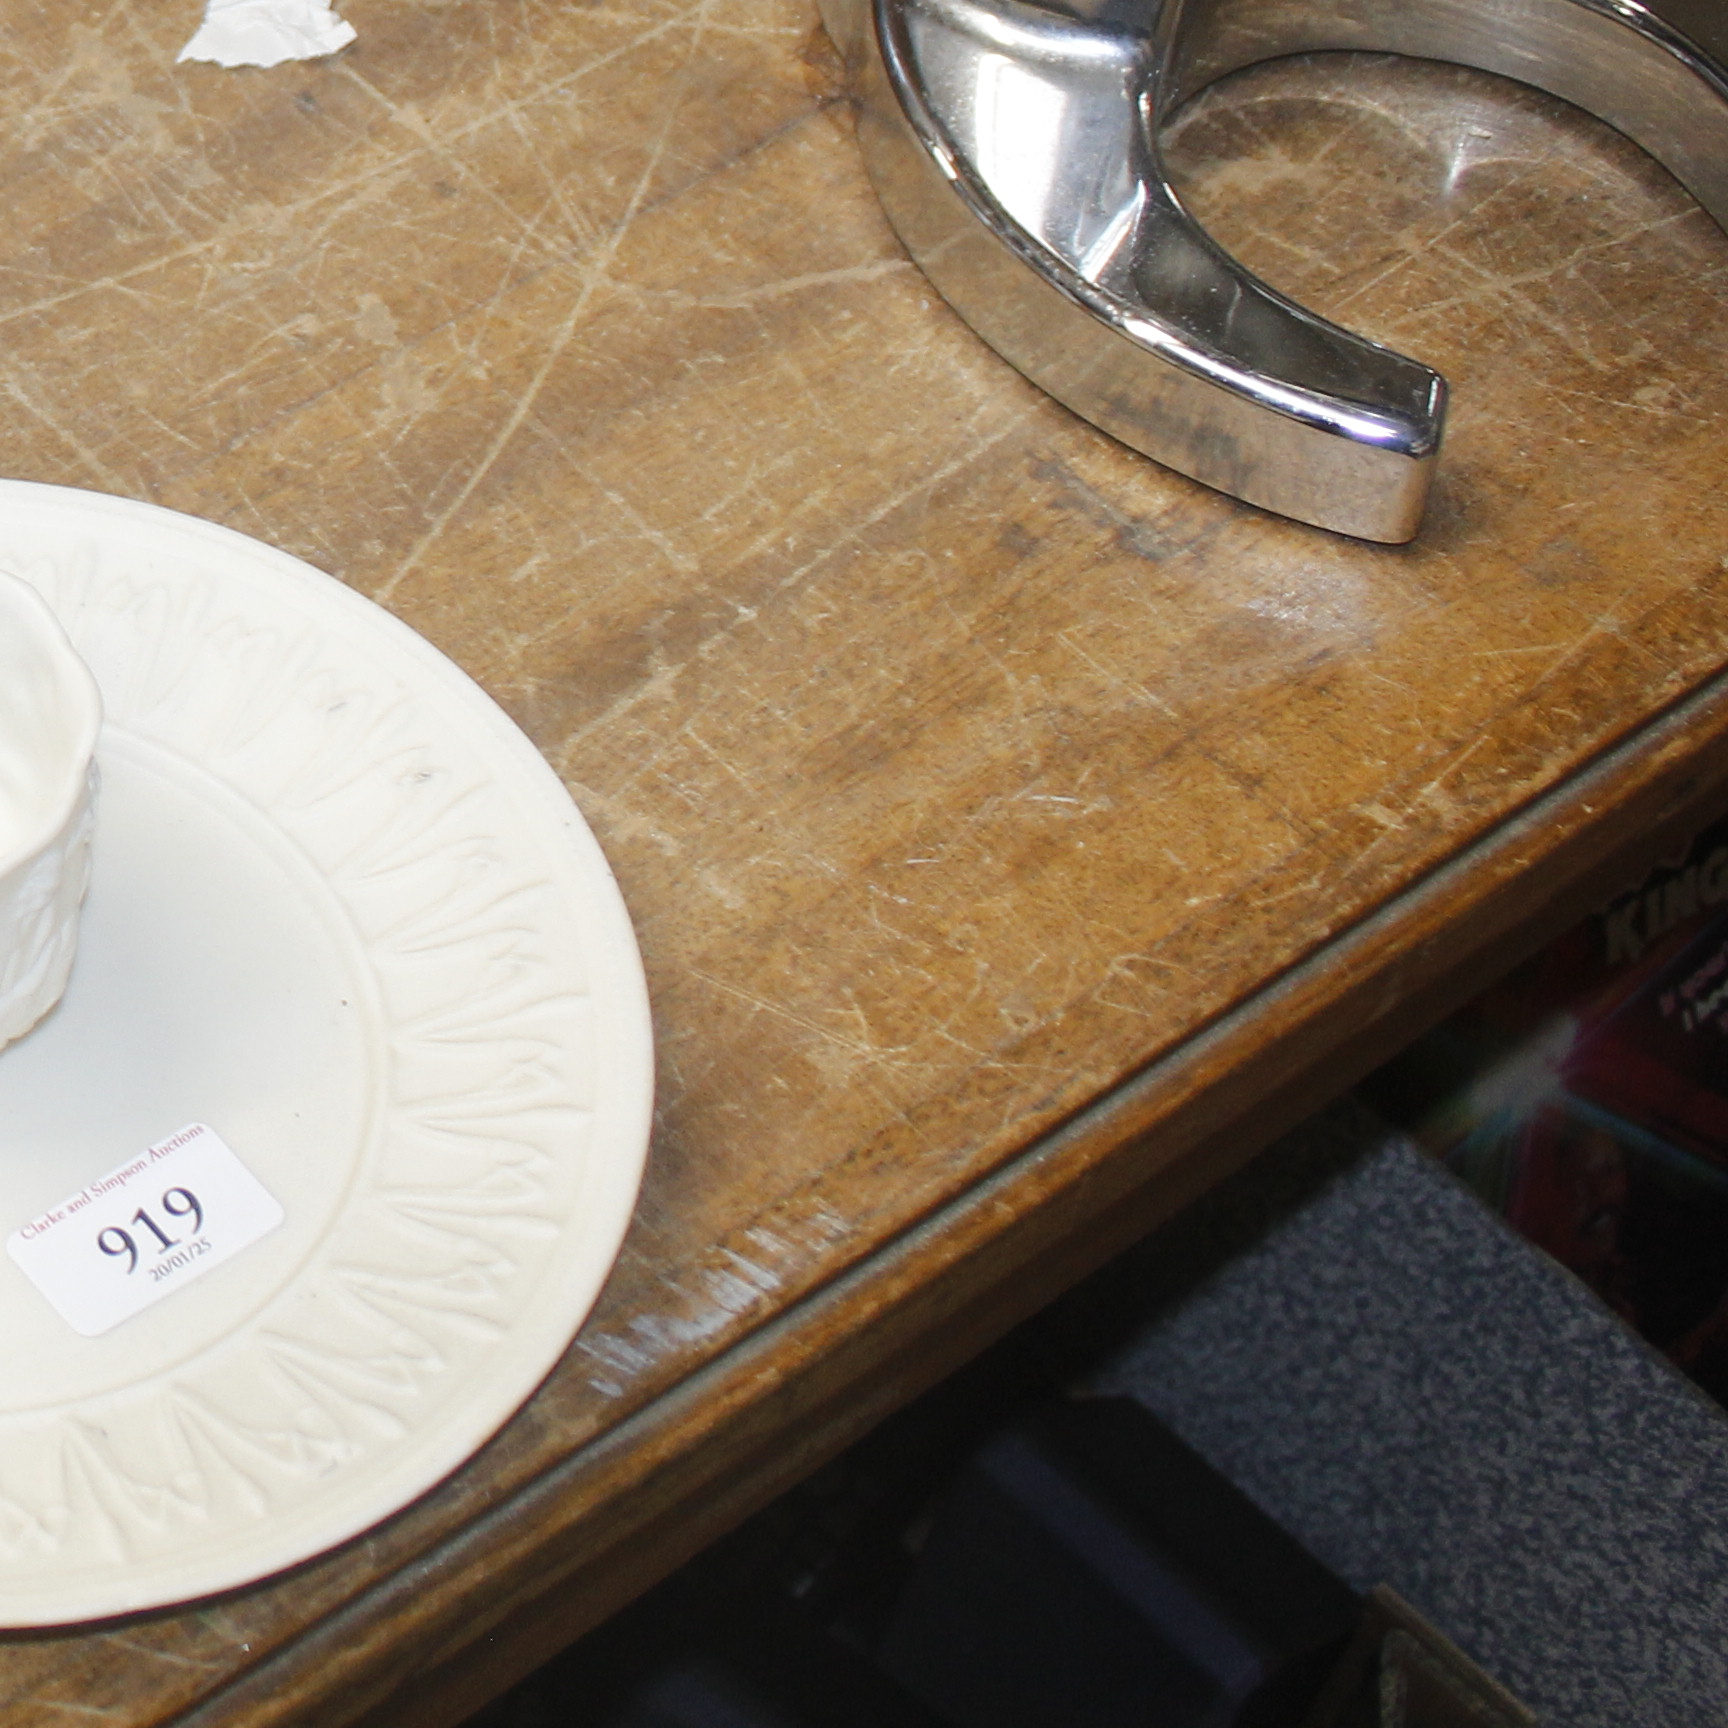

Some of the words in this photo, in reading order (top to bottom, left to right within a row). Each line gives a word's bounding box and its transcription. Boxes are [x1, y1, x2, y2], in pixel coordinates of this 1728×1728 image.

[20, 1208, 66, 1241] Clarke
[67, 1191, 93, 1215] and
[90, 1158, 148, 1199] Simpson
[148, 1123, 206, 1164] Auctions
[97, 1186, 204, 1275] 919
[148, 1236, 212, 1282] 20/01/25
